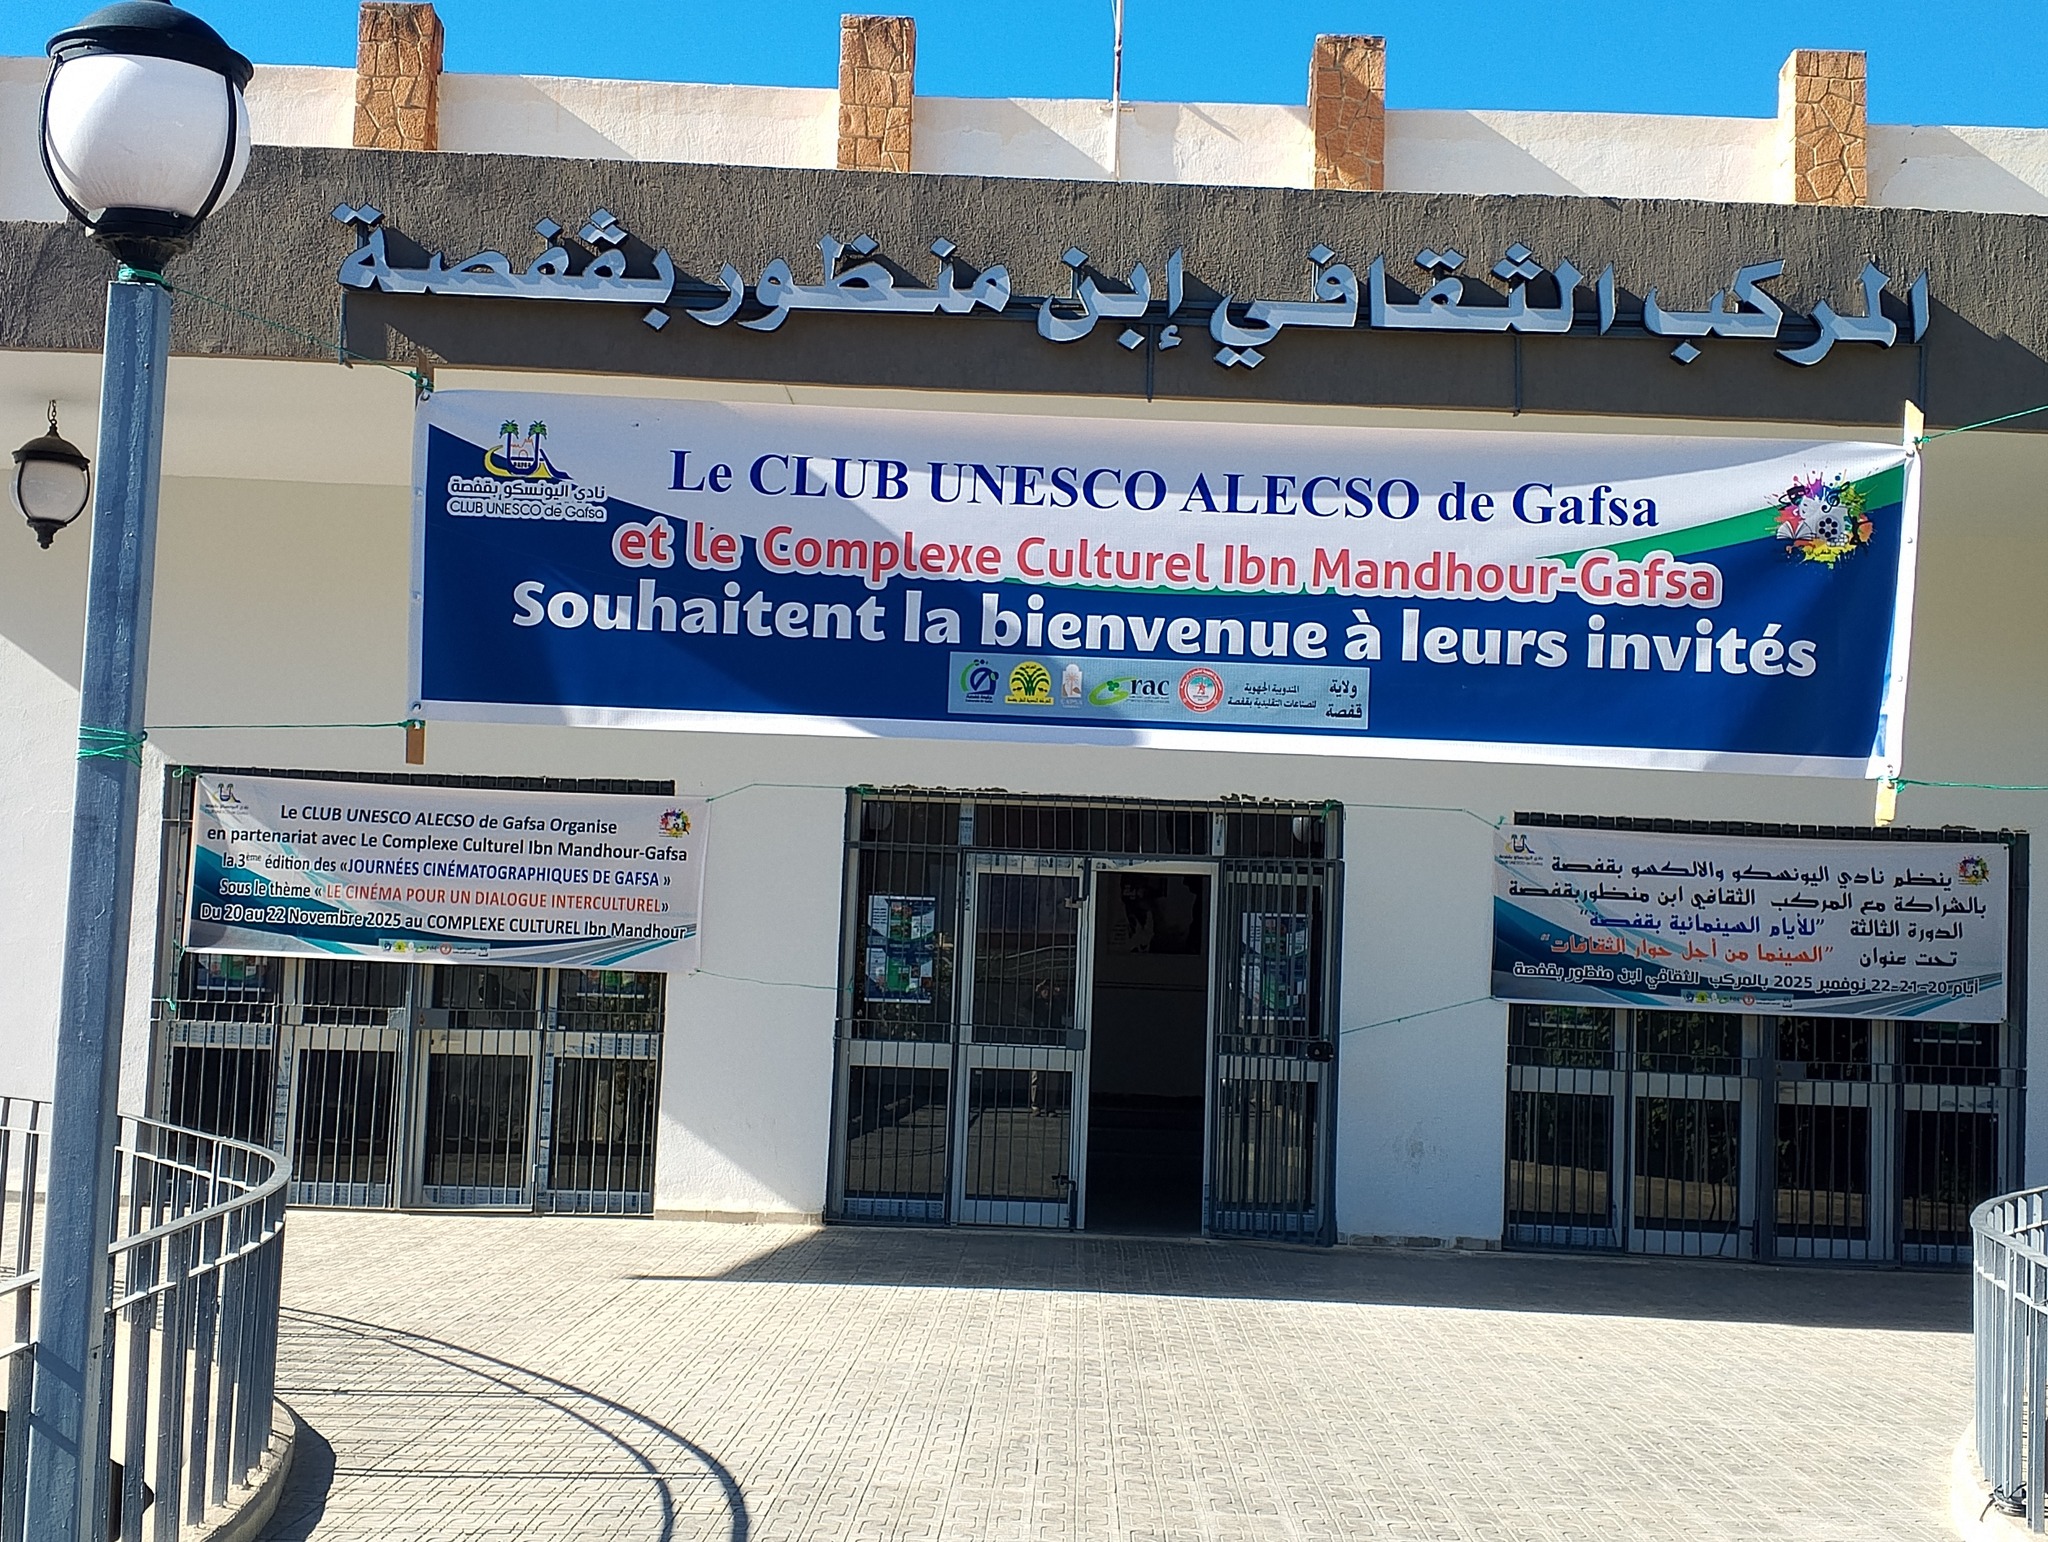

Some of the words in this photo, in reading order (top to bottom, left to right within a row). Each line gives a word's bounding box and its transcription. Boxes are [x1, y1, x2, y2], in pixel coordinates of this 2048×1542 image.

[330, 203, 677, 332] بقفصة
[684, 232, 1011, 332] منظور
[1209, 242, 1617, 371] الثقافي
[1643, 257, 1931, 367] المركب
[451, 479, 498, 498] بقفصة
[503, 482, 569, 504] اليونسكو
[573, 485, 606, 503] نادي
[668, 449, 733, 494] Le
[749, 452, 909, 502] CLUB
[926, 460, 1168, 512] UNESCO
[1180, 471, 1421, 522] ALECSO
[1437, 481, 1495, 523] de
[1511, 483, 1661, 529] Gafsa
[450, 500, 484, 513] CLUB
[486, 501, 542, 516] UNESCO
[545, 504, 562, 517] de
[565, 505, 604, 519] Gafsa
[619, 525, 670, 563] et
[693, 521, 736, 565] le
[763, 525, 1003, 584] Complexe
[1017, 536, 1210, 585] Culturel
[1223, 542, 1297, 587] Ibn
[1311, 547, 1716, 601] Mandhour-Gafsa
[513, 578, 886, 641] Souhaitent
[905, 590, 961, 646] la
[981, 591, 1328, 658] bienvenue
[1344, 608, 1382, 661] à
[1402, 608, 1568, 669] leurs
[1587, 614, 1818, 677] invités
[1329, 679, 1358, 699] ولاية
[1325, 703, 1363, 719] قفصة
[281, 805, 298, 820] Le
[302, 806, 342, 822] CLUB
[347, 808, 412, 825] UNESCO
[415, 810, 475, 829] ALECSO
[479, 814, 498, 829] de
[502, 816, 546, 832] Gafsa
[550, 818, 618, 836] Organise
[207, 828, 226, 842] en
[231, 828, 318, 845] partenariat
[321, 833, 356, 847] avec
[361, 833, 378, 848] Le
[382, 834, 459, 853] Complexe
[463, 837, 525, 855] Culturel
[528, 840, 553, 856] Ibn
[558, 842, 687, 862] Mandhour-Gafsa
[222, 852, 236, 868] la
[265, 854, 310, 871] édition
[314, 856, 336, 872] des
[423, 860, 589, 885] CINÉMATOGRAPHIQUES
[592, 870, 611, 885] DE
[614, 870, 660, 887] GAFSA
[1551, 857, 1623, 879] بقفصة
[1732, 864, 1830, 887] اليونسكو
[1838, 867, 1885, 889] نادي
[1893, 868, 1952, 892] ينظم
[219, 879, 252, 895] Sous
[254, 880, 267, 896] le
[269, 881, 311, 898] thème
[327, 884, 342, 899] LE
[345, 882, 401, 901] CINÉMA
[406, 887, 446, 904] POUR
[450, 889, 470, 905] UN
[475, 890, 547, 908] DIALOGUE
[1658, 885, 1684, 907] ابن
[1690, 887, 1756, 910] الثقافي
[1771, 891, 1852, 913] المركب
[1860, 900, 1886, 915] مع
[1893, 895, 1987, 919] بالشراكة
[201, 904, 222, 920] Du
[223, 904, 243, 920] 20
[245, 908, 263, 921] au
[268, 906, 286, 922] 22
[289, 908, 363, 926] Novembre
[366, 912, 401, 927] 2025
[405, 916, 422, 929] au
[427, 914, 505, 932] COMPLEXE
[509, 917, 580, 936] CULTUREL
[584, 921, 607, 937] Ibn
[611, 922, 687, 940] Mandhour
[1670, 913, 1760, 937] السينمائية
[1850, 918, 1899, 938] الثالثة
[1908, 922, 1963, 943] الدورة
[1634, 938, 1673, 960] حوار
[1682, 938, 1718, 963] أجل
[1725, 949, 1750, 962] من
[1859, 947, 1907, 969] عنوان
[1915, 951, 1958, 968] تحت
[1513, 962, 1564, 979] بقفصة
[1567, 965, 1614, 983] منظور
[1618, 968, 1642, 984] ابن
[1646, 971, 1699, 989] الثقافي
[1707, 972, 1769, 990] بالمركب
[1773, 975, 1813, 989] 2025
[1815, 978, 1867, 995] نوفمبر
[1951, 978, 1980, 998] أيام
